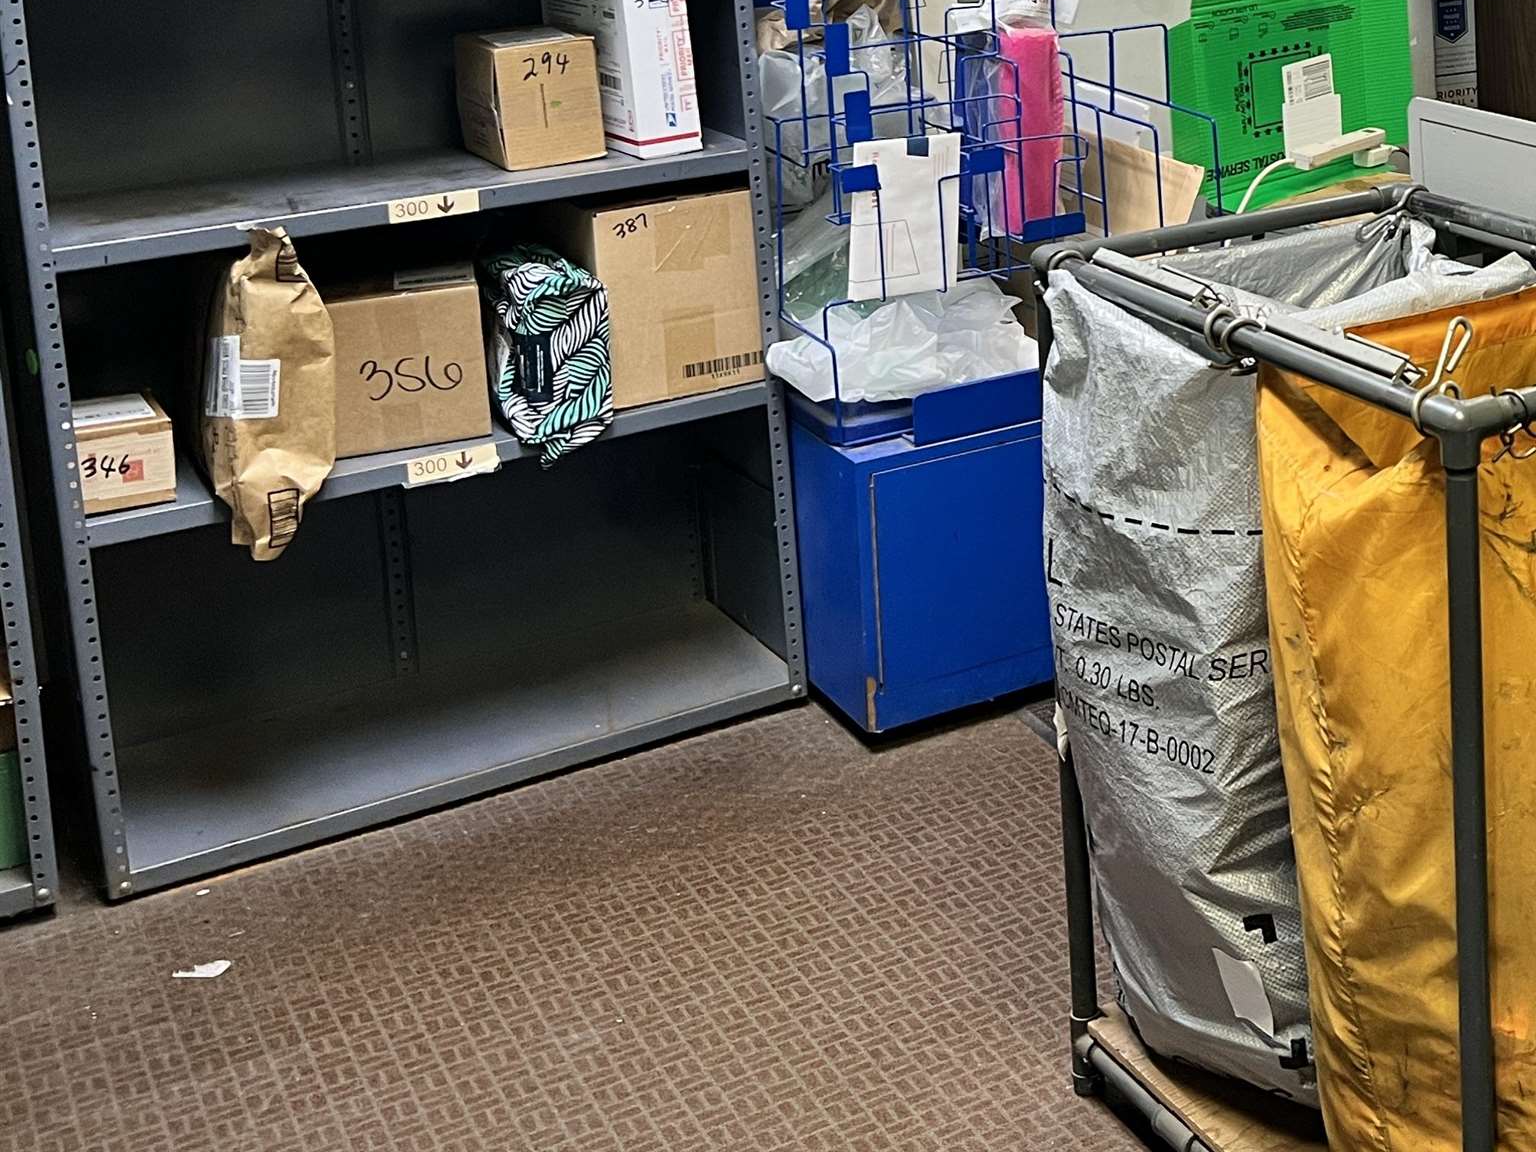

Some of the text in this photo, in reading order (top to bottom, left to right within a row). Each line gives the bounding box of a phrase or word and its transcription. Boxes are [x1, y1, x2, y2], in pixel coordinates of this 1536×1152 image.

[522, 52, 570, 83] 294
[1437, 87, 1478, 100] RIORITY
[1206, 151, 1286, 183] OSTAL SERVICE
[395, 200, 429, 218] 300
[612, 213, 648, 239] 387
[359, 358, 463, 400] 356
[81, 454, 130, 479] 346
[414, 458, 448, 476] 300
[1054, 603, 1269, 682] STATES POSTAL SER
[1075, 655, 1111, 690] 0.30
[1117, 674, 1160, 710] LBS.
[1060, 685, 1216, 775] CMTEQ-17-B-0002
